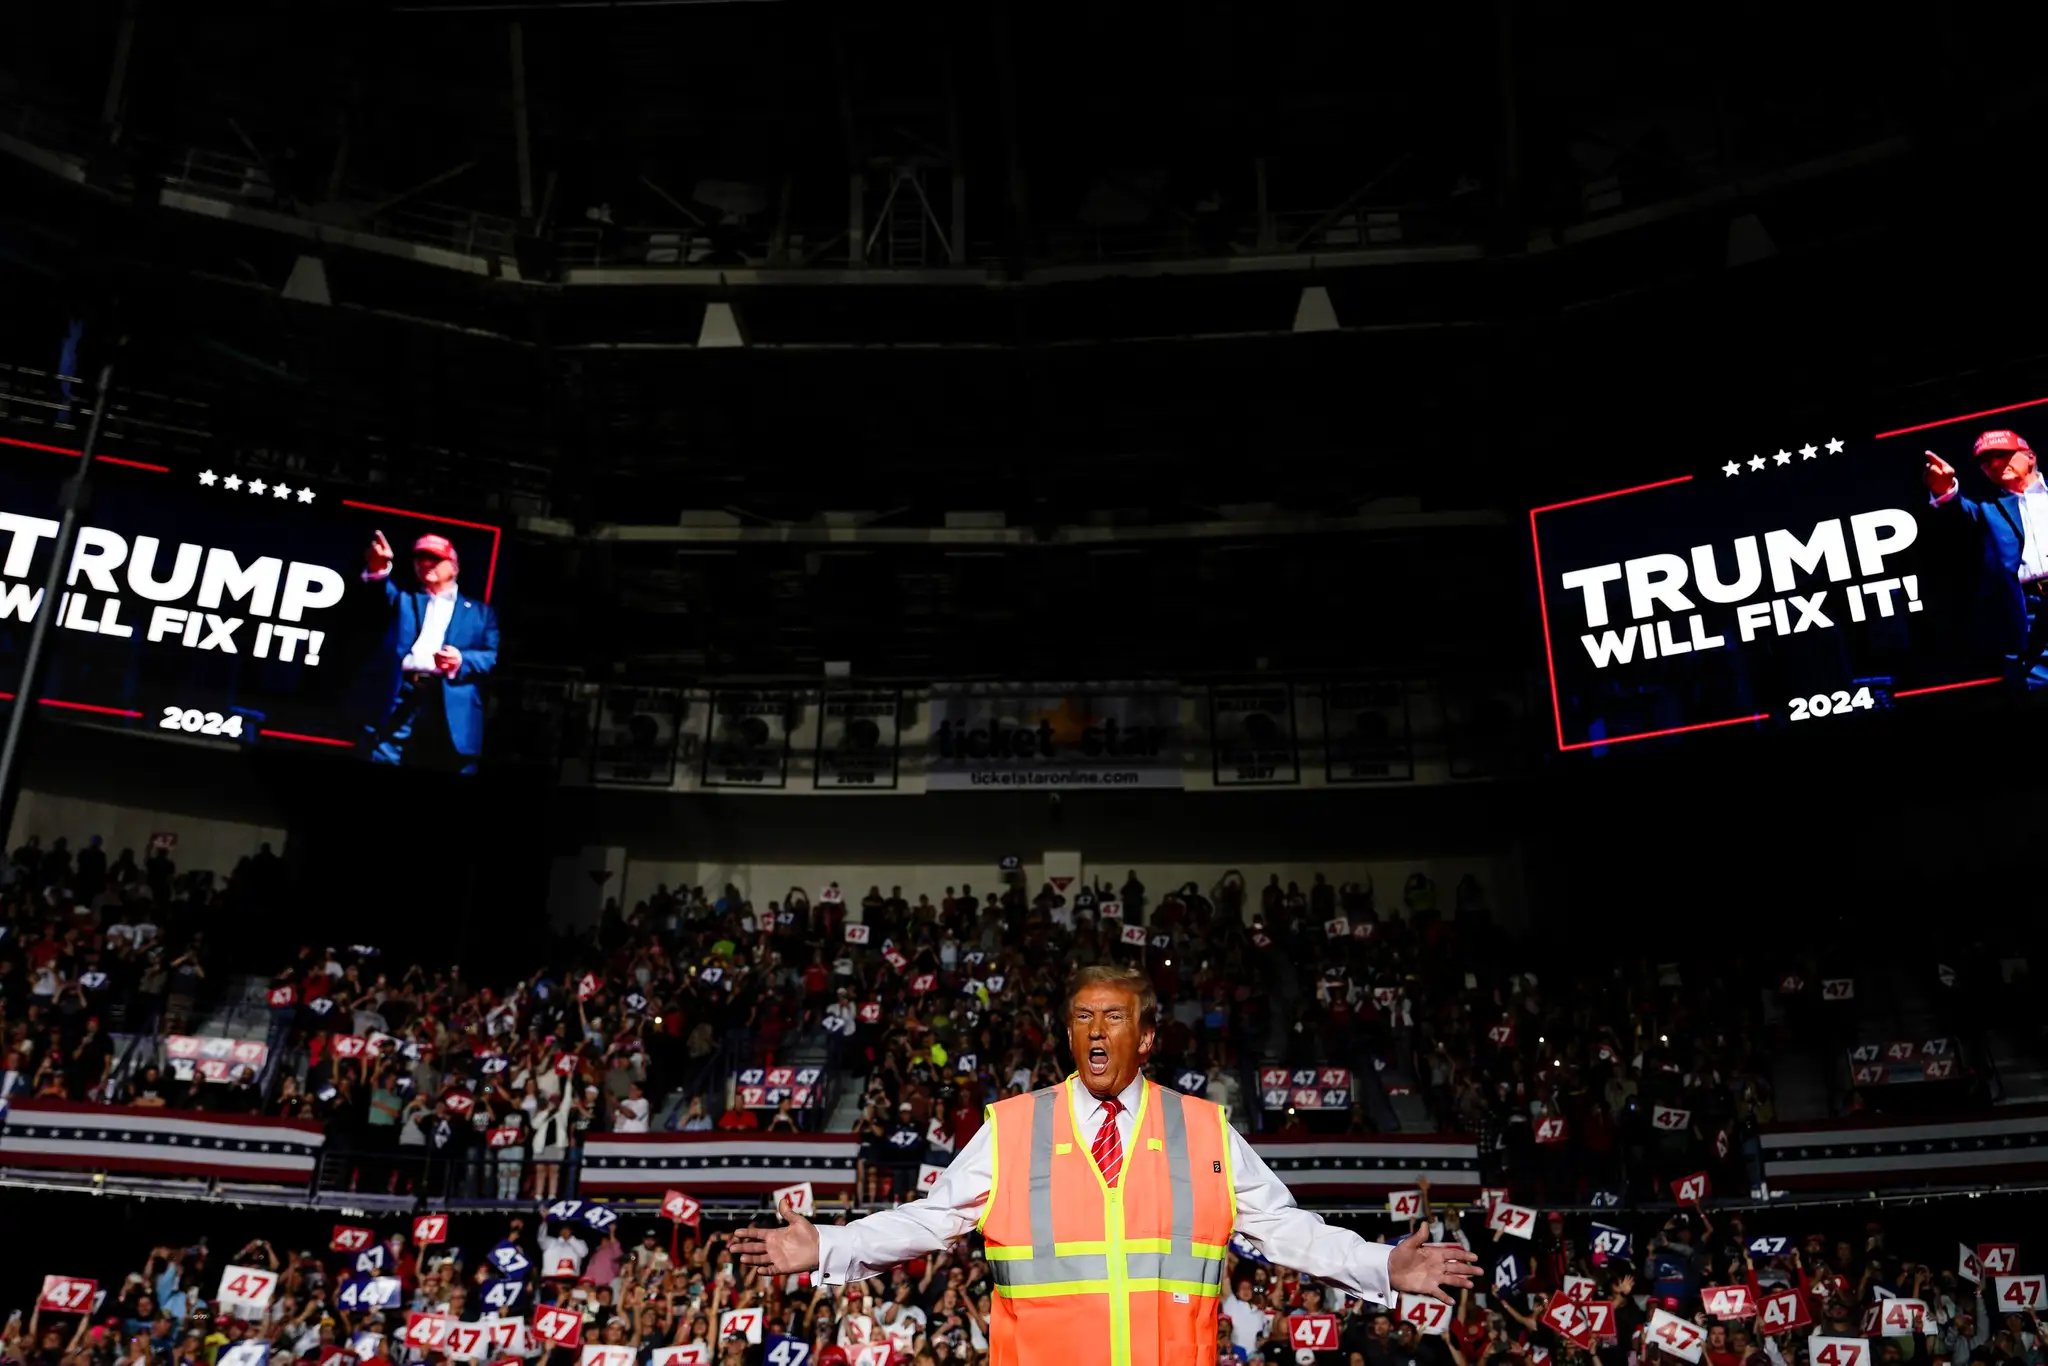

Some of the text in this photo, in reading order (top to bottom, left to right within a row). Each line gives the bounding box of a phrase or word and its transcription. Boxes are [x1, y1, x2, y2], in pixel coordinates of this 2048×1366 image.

[0, 512, 345, 622] TRUMP
[1562, 508, 1918, 628] TRUMP
[1580, 574, 1924, 668] WILL FIX IT!
[147, 605, 244, 655] FIX
[252, 622, 326, 666] IT!
[1787, 686, 1875, 722] 2024
[159, 704, 243, 738] 2024
[940, 717, 1168, 758] ticket star
[970, 771, 1138, 786] ticketstaronline.com
[1102, 904, 1120, 914] 47
[848, 929, 866, 940] 47
[1126, 930, 1145, 941] 47
[1354, 923, 1374, 937] 47
[1152, 934, 1171, 949] 47
[701, 968, 723, 983] 47
[913, 974, 934, 991] 47
[1826, 982, 1849, 996] 47
[861, 1003, 881, 1020] 47
[822, 1016, 845, 1032] 47
[1488, 1026, 1510, 1043] 47
[336, 1038, 365, 1056] 47
[1854, 1046, 1879, 1061] 47
[1888, 1044, 1913, 1059] 47
[1922, 1039, 1947, 1054] 47
[958, 1053, 977, 1071] 47
[1927, 1060, 1951, 1077] 47
[740, 1069, 764, 1084] 47
[768, 1069, 792, 1084] 47
[796, 1069, 820, 1084] 47
[1178, 1072, 1206, 1092] 47
[1263, 1069, 1288, 1086] 47
[1293, 1069, 1316, 1085] 47
[1322, 1069, 1345, 1085] 47
[1857, 1067, 1882, 1082] 47
[1265, 1088, 1288, 1105] 47
[1295, 1089, 1318, 1106] 47
[1324, 1089, 1347, 1105] 47
[1658, 1112, 1685, 1126] 47
[492, 1130, 518, 1146] 47
[889, 1132, 918, 1145] 47
[1537, 1120, 1564, 1140] 47
[1679, 1176, 1705, 1200] 47
[550, 1200, 583, 1217] 47
[666, 1196, 698, 1220] 47
[1395, 1194, 1420, 1214] 47
[584, 1206, 617, 1226] 47
[1498, 1209, 1529, 1229] 47
[336, 1230, 368, 1247] 47
[415, 1218, 444, 1239] 47
[1594, 1231, 1627, 1254] 47
[1751, 1237, 1786, 1253] 47
[356, 1246, 384, 1272] 47
[495, 1247, 529, 1272] 47
[1984, 1248, 2016, 1272] 47
[1495, 1255, 1518, 1289] 47
[47, 1281, 92, 1308] 47
[228, 1275, 269, 1299] 47
[358, 1278, 396, 1305] 47
[484, 1281, 523, 1307] 47
[1568, 1282, 1596, 1302] 47
[2004, 1281, 2041, 1305] 47
[1710, 1290, 1746, 1314] 47
[1764, 1294, 1796, 1325] 47
[723, 1315, 755, 1334] 47
[1408, 1303, 1446, 1327] 47
[1551, 1303, 1588, 1336] 47
[409, 1317, 445, 1344] 47
[536, 1311, 577, 1341] 47
[1294, 1319, 1331, 1346] 47
[1656, 1321, 1700, 1350] 47
[448, 1328, 480, 1353] 47
[768, 1340, 809, 1366] 47
[1817, 1344, 1861, 1366] 47
